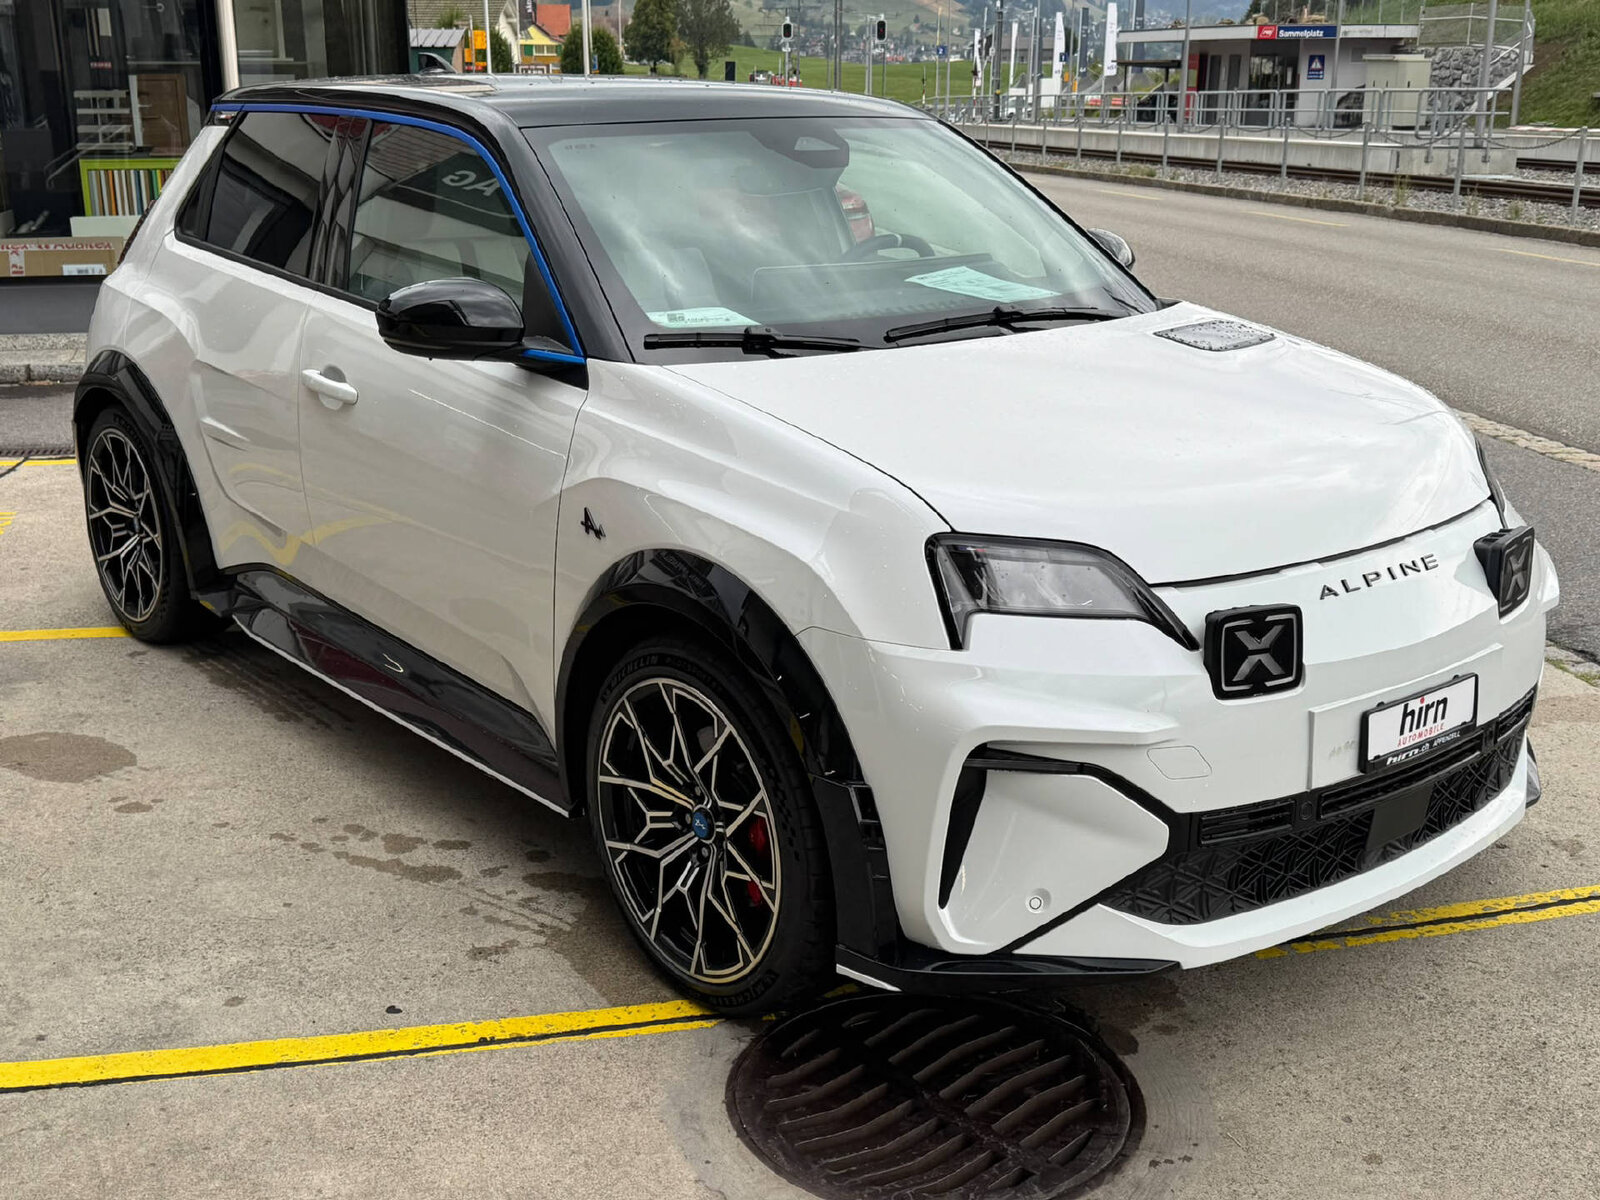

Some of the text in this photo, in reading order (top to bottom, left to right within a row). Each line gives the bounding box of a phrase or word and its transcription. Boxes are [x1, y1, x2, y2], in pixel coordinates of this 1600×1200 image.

[1278, 29, 1324, 40] Sammelplatz
[1319, 553, 1439, 601] ALPINE
[1399, 695, 1448, 736] hirn
[1397, 722, 1446, 748] AUTOMOBILE
[1386, 742, 1430, 766] hirn.ch
